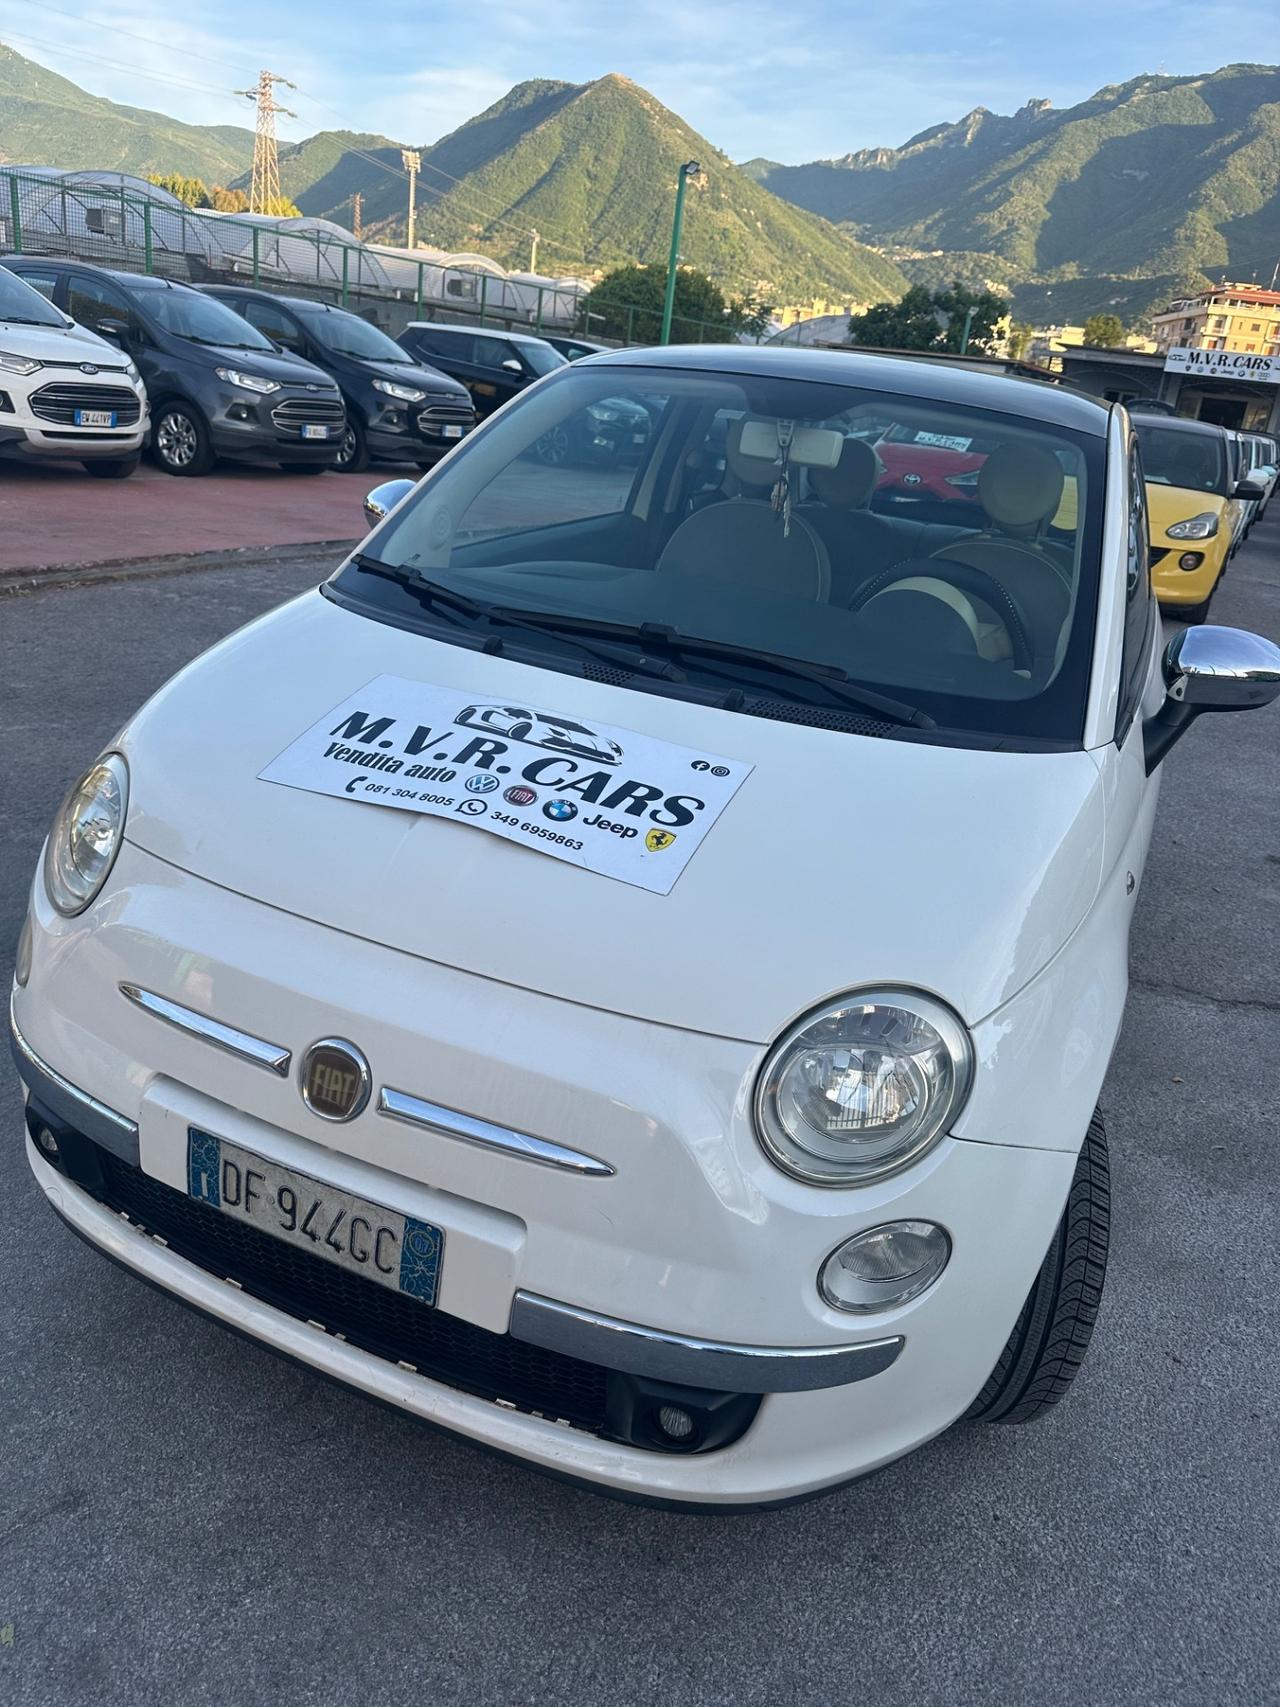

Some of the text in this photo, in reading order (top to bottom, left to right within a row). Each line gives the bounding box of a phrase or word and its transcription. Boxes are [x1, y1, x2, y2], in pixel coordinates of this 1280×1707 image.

[1188, 351, 1273, 371] M.V.R.CARS
[323, 741, 457, 783] Vendita auto
[364, 783, 456, 807] 081 304 8005
[490, 811, 584, 851] 349 6959863
[583, 814, 639, 839] Jeep
[311, 1063, 355, 1107] FIAT
[222, 1159, 266, 1213] DF
